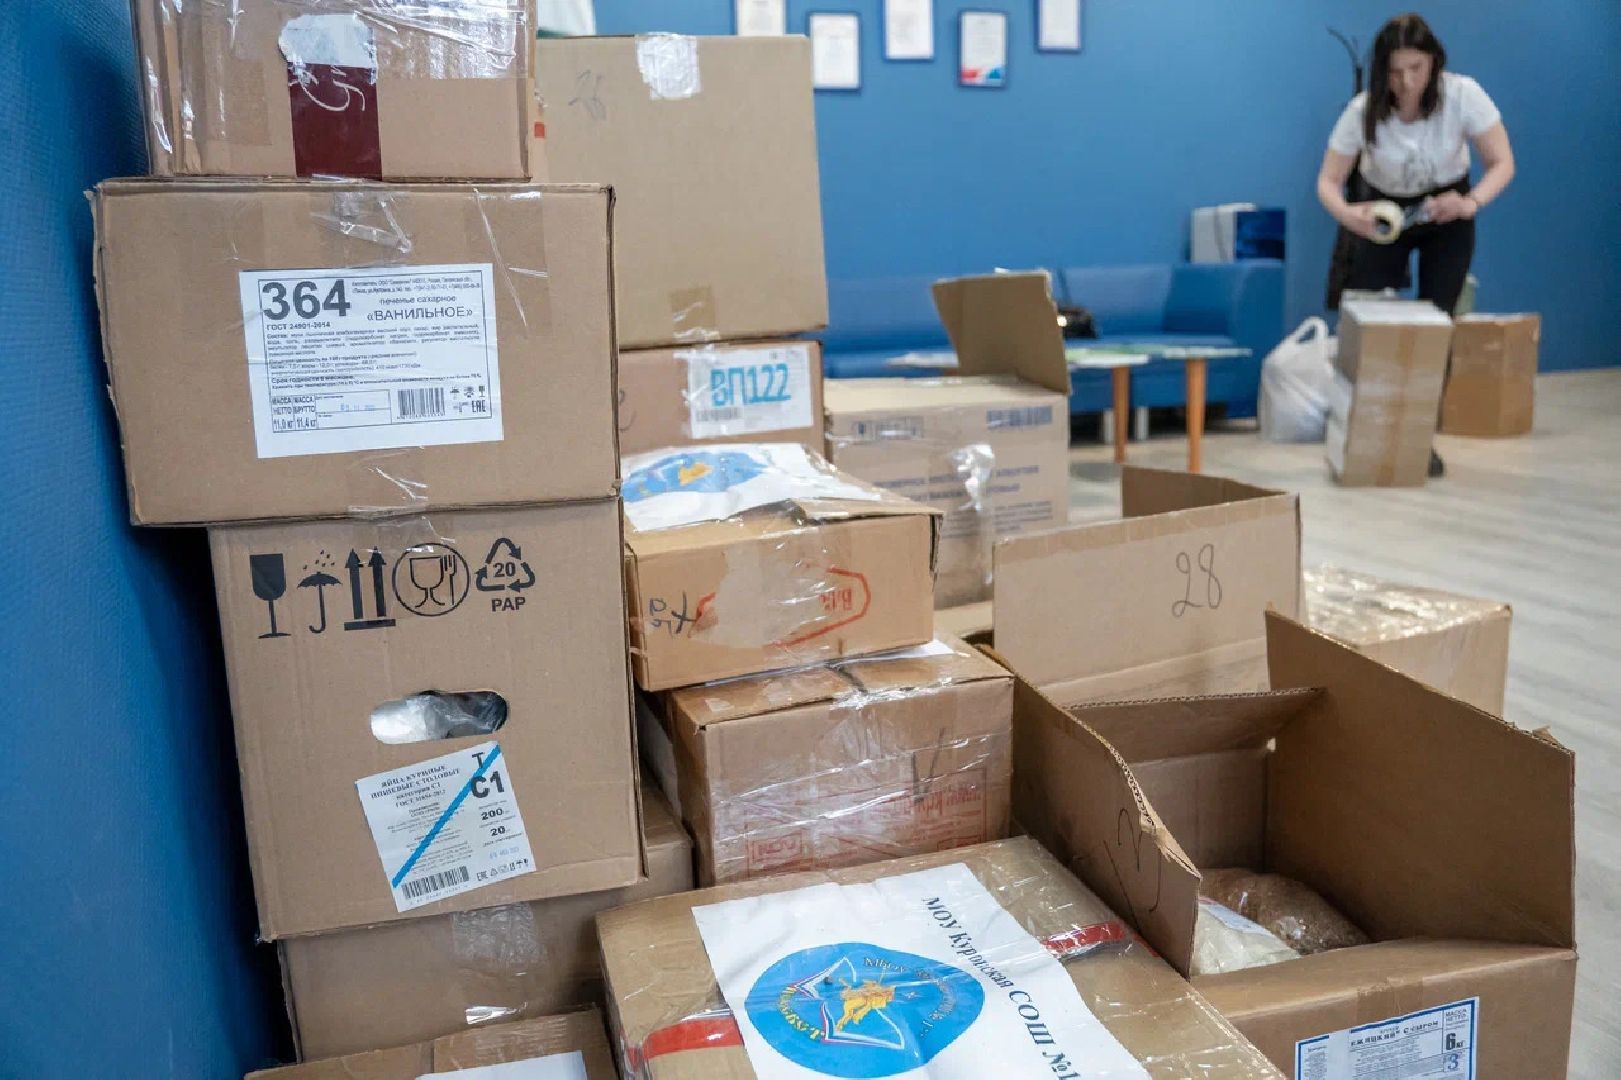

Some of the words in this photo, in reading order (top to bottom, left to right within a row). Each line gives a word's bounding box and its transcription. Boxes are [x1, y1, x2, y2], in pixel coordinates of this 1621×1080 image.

[262, 279, 351, 320] 364
[367, 306, 473, 321] «ВАНИЛЬНОЕ»
[273, 406, 292, 414] НЕТТО
[293, 405, 315, 413] БРУТТО
[493, 562, 516, 577] 20
[1172, 543, 1223, 617] 28
[491, 596, 526, 612] PAP
[481, 808, 503, 820] 200
[491, 826, 506, 836] 20
[924, 897, 961, 929] МОУ
[1008, 990, 1055, 1044] СОШ
